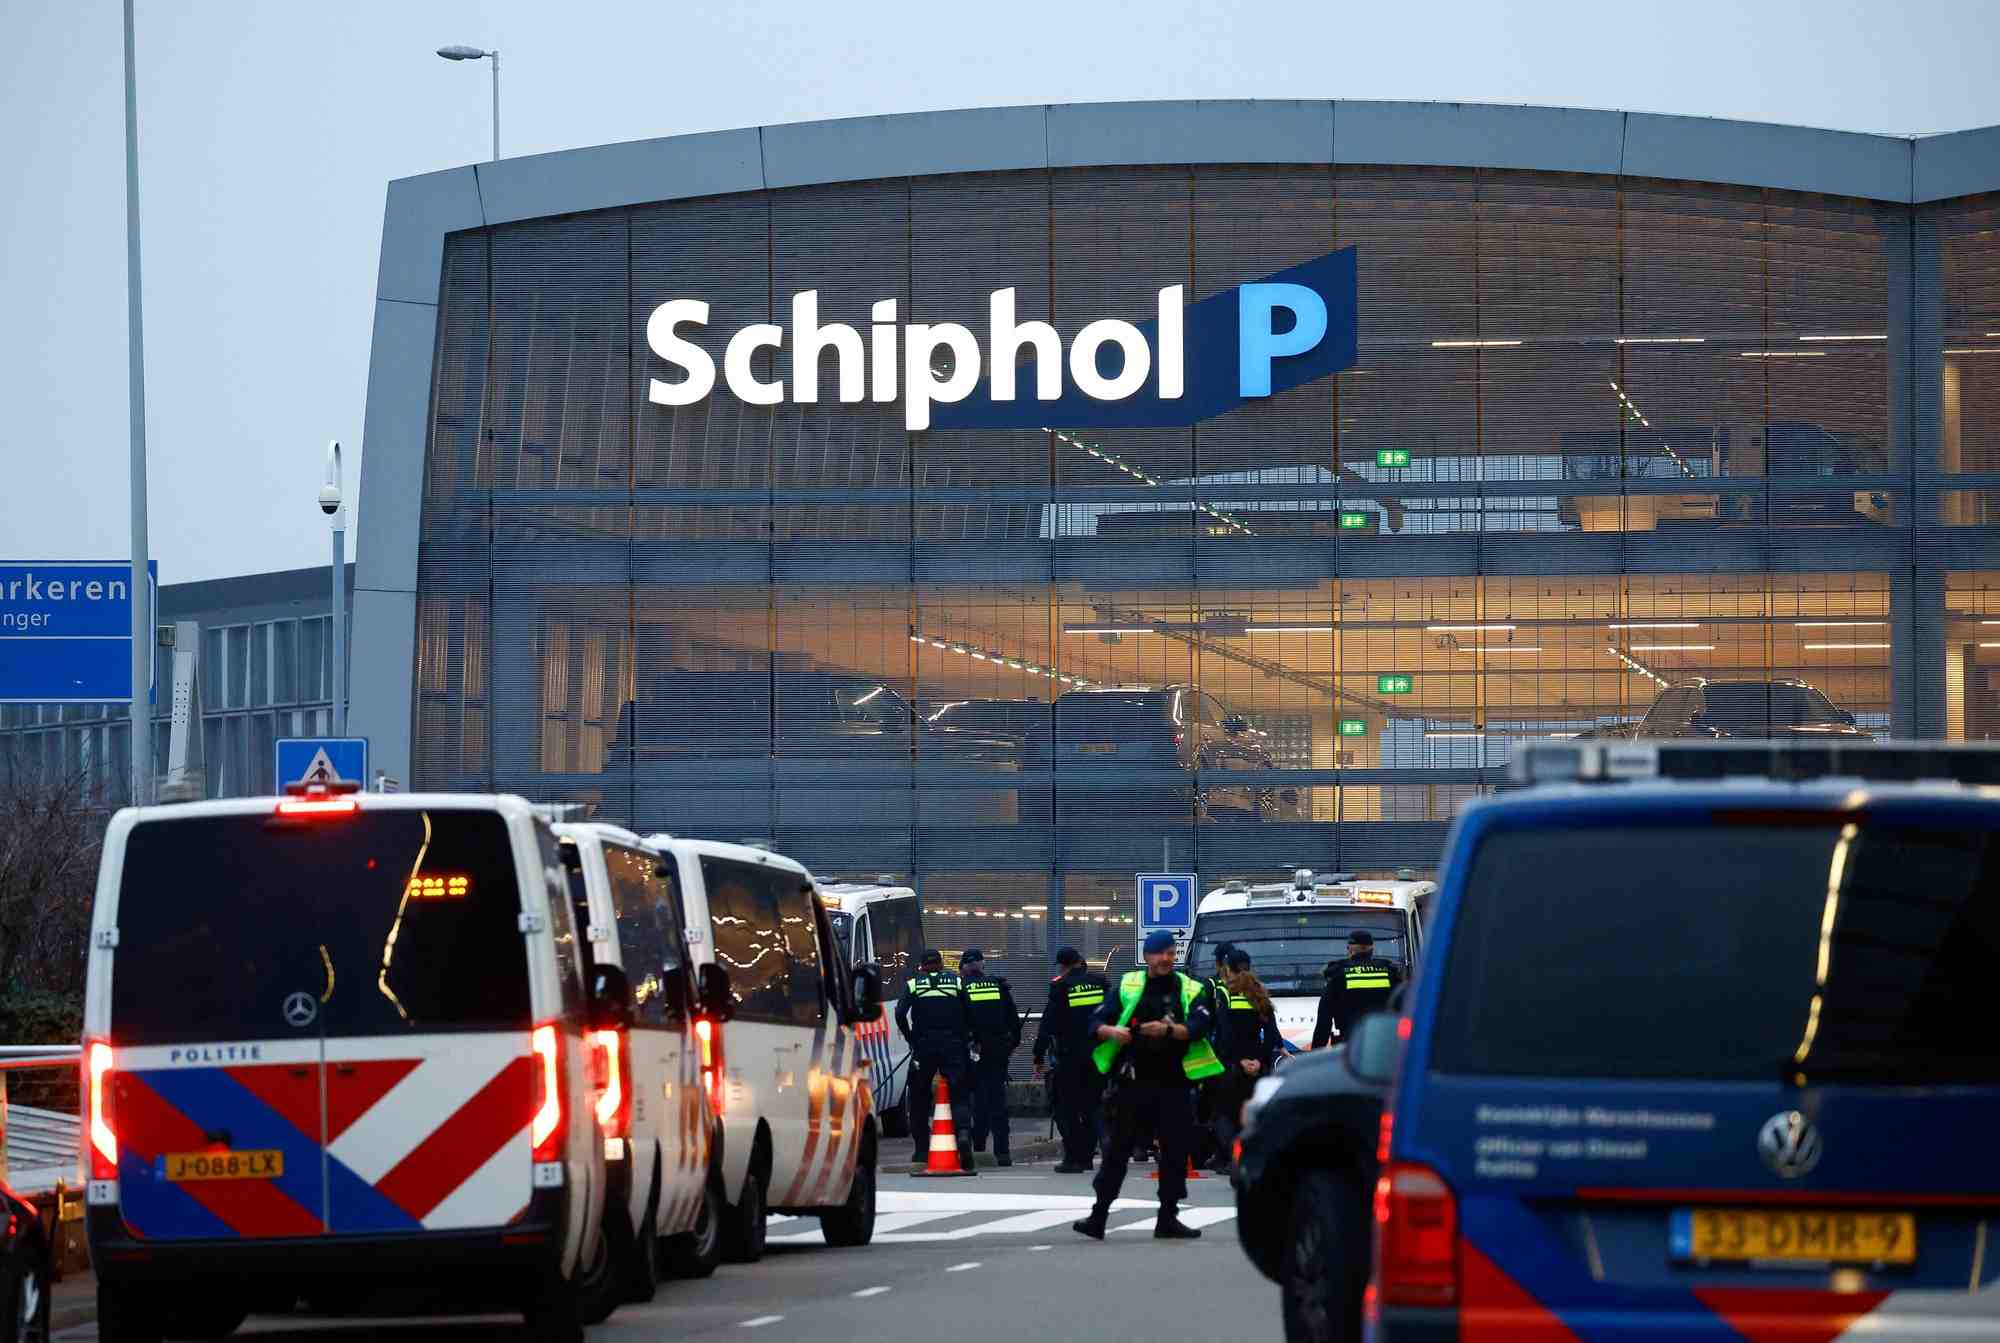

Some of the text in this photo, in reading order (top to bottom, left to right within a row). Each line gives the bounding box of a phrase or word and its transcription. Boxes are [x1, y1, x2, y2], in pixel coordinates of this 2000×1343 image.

[647, 283, 1328, 430] Schiphol P
[0, 573, 126, 600] rkeren
[1153, 884, 1180, 921] P
[171, 1046, 261, 1062] POLITIE
[176, 1154, 276, 1177] J-088-LX
